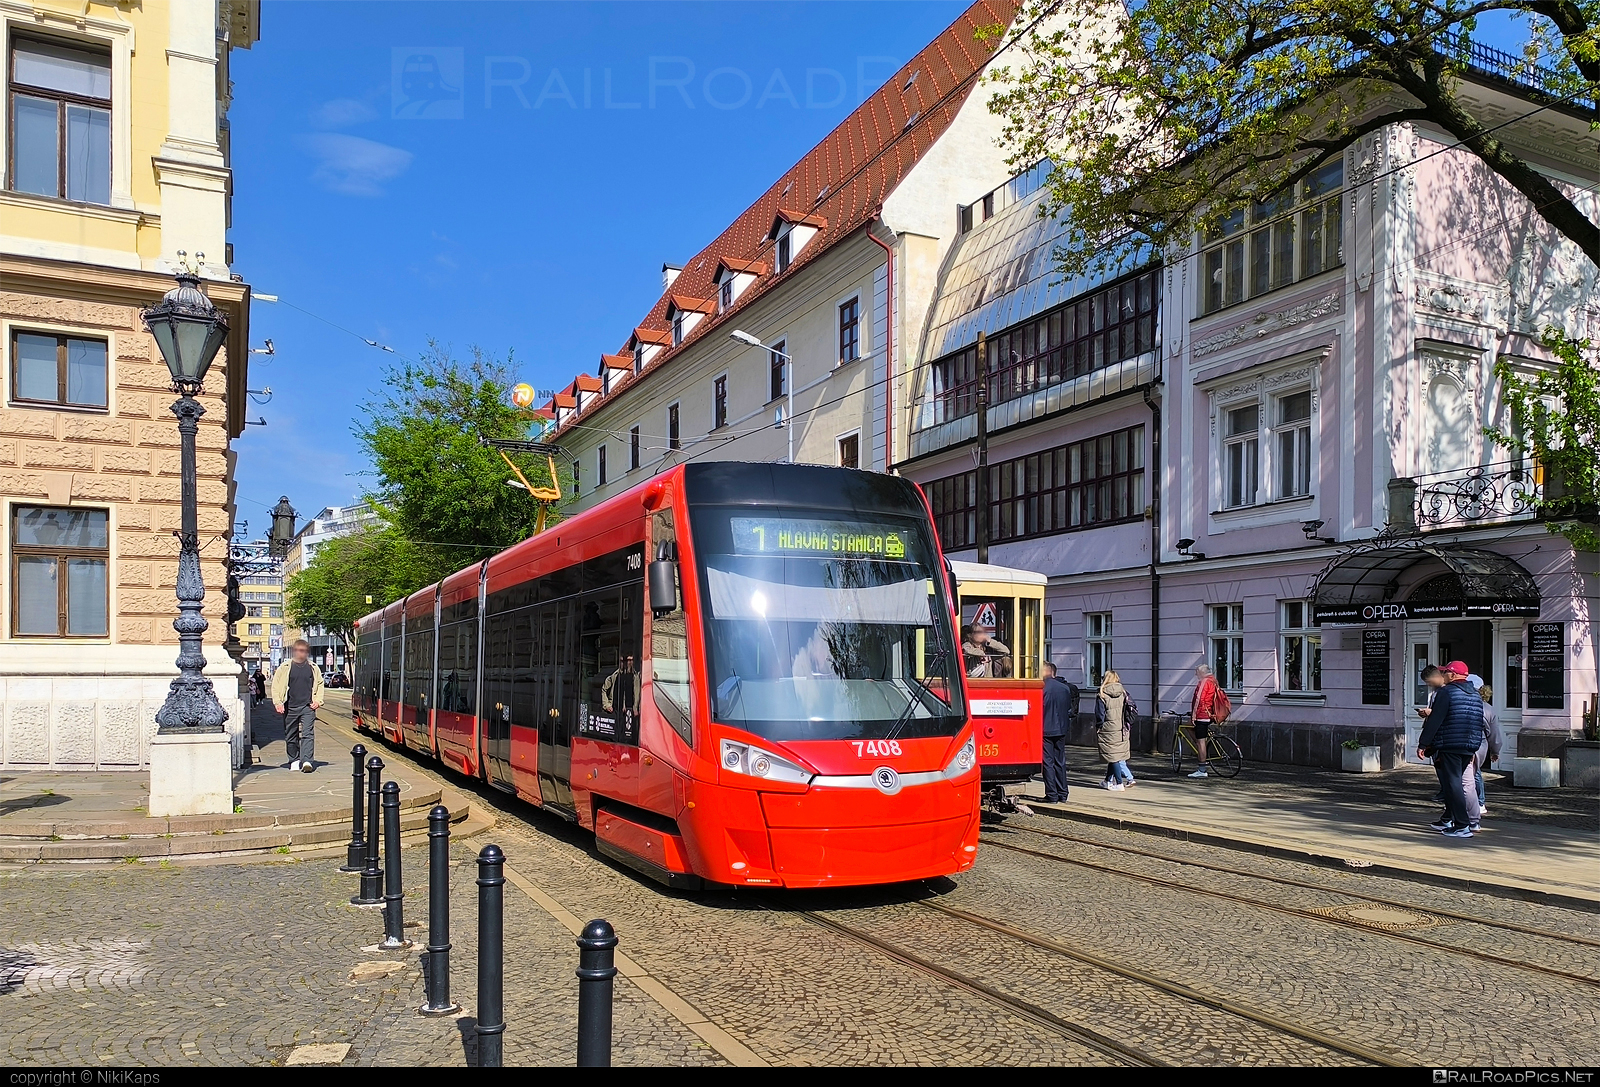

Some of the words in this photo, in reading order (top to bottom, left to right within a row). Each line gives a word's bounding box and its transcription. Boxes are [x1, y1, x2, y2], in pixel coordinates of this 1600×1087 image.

[753, 525, 765, 551] 1
[778, 529, 828, 549] HLAVNÁ
[831, 532, 882, 553] STANICA
[627, 552, 641, 571] 7408
[1362, 605, 1408, 619] OPERA
[1492, 603, 1515, 613] OPERA
[1532, 624, 1560, 632] OPERA
[1365, 631, 1387, 639] OPERA
[852, 740, 903, 758] 7408
[979, 744, 999, 757] 135
